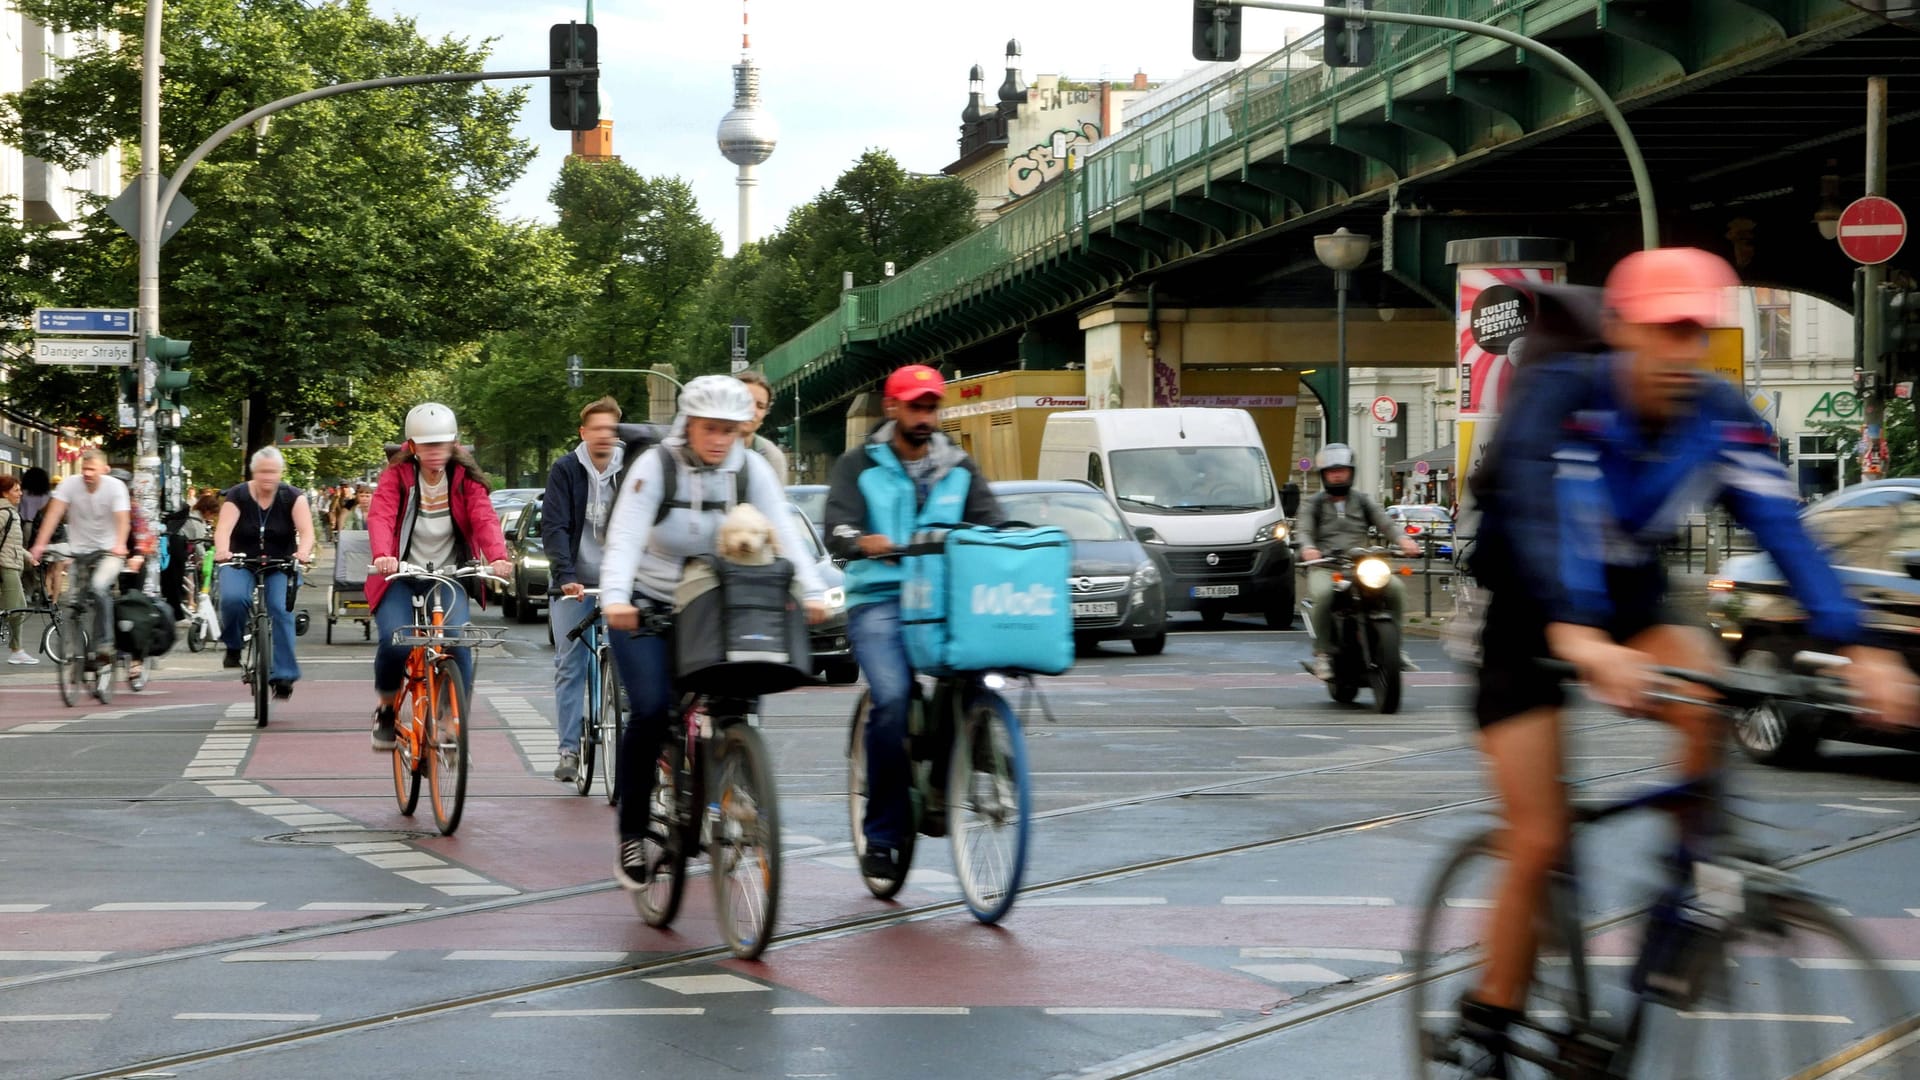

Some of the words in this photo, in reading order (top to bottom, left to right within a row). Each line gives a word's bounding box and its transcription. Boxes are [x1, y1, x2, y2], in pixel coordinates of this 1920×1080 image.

[1480, 299, 1520, 317] KULTUR
[1473, 309, 1518, 328] SOMMER
[1481, 315, 1528, 335] FESTIVAL
[40, 344, 89, 360] Danziger
[91, 345, 129, 361] Straße
